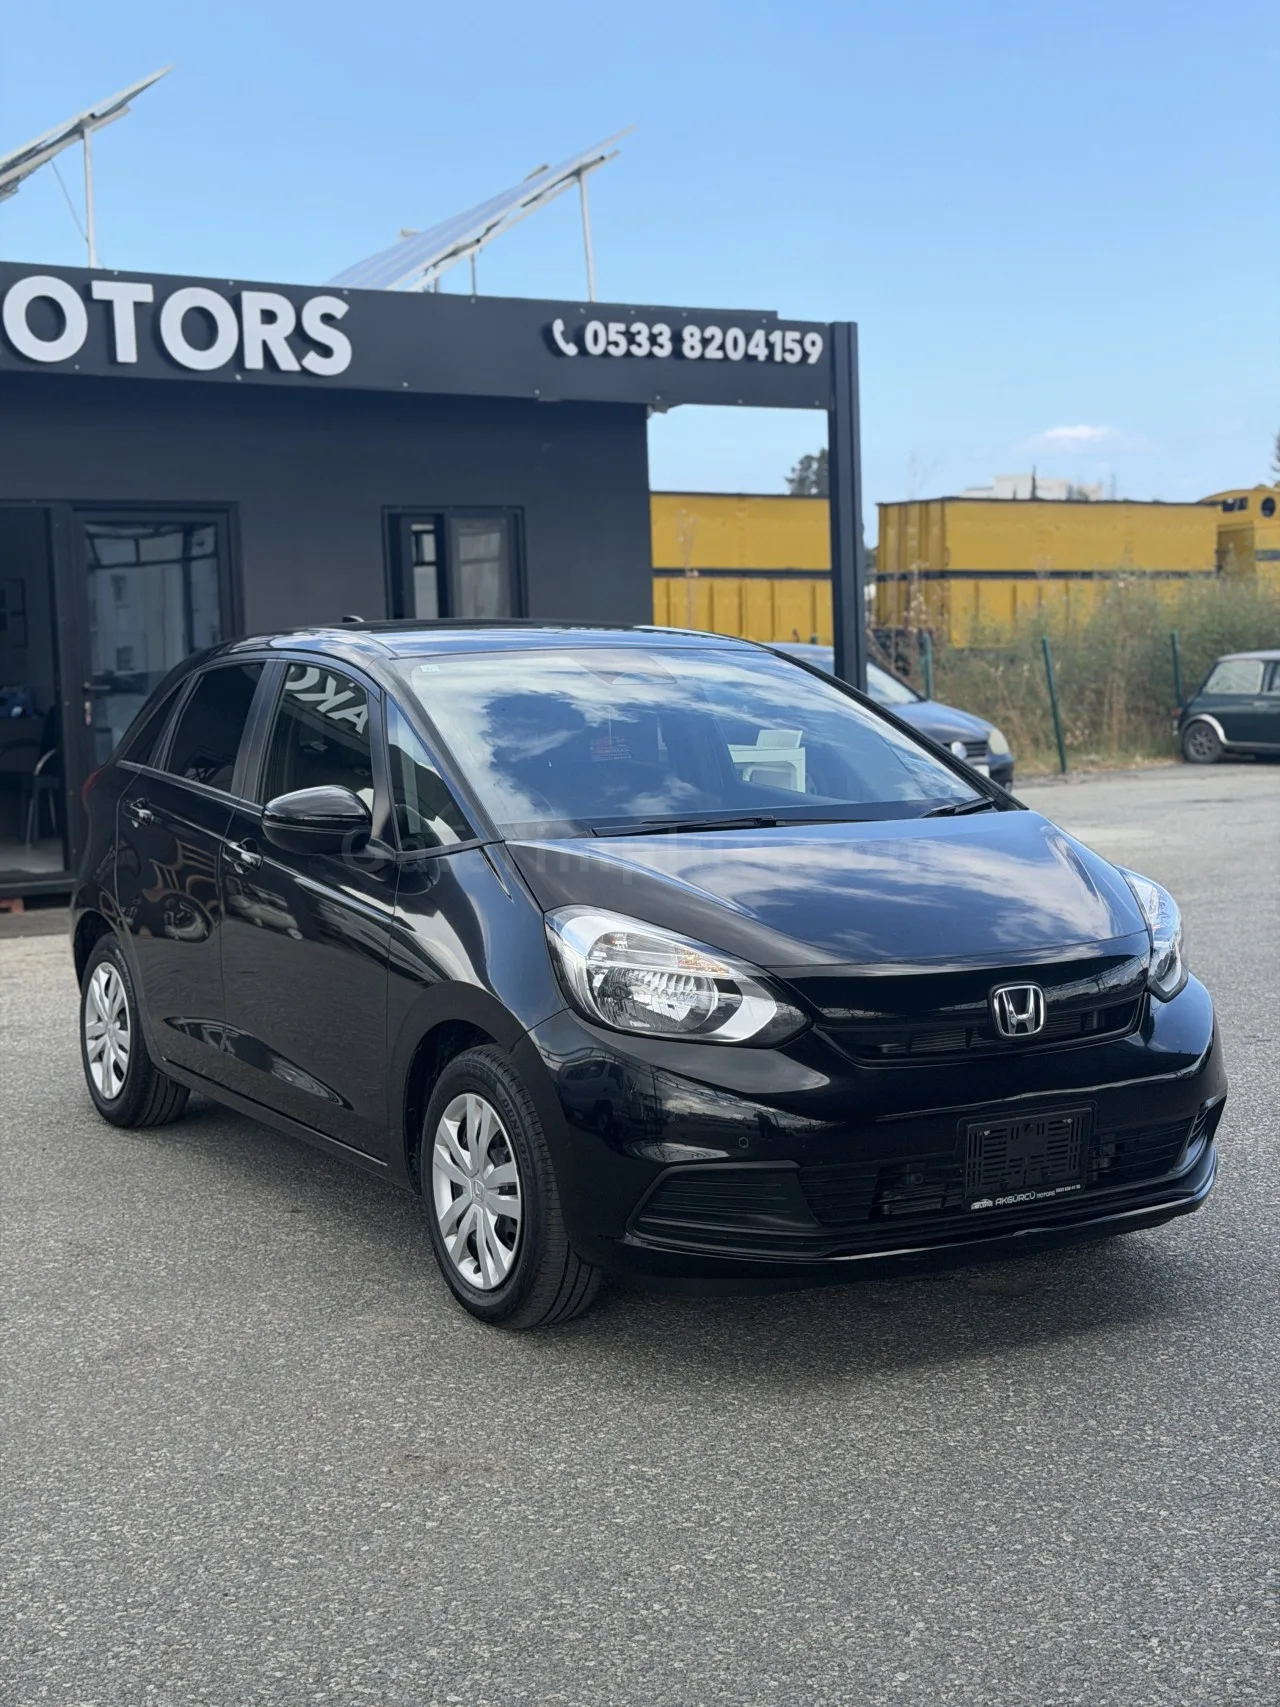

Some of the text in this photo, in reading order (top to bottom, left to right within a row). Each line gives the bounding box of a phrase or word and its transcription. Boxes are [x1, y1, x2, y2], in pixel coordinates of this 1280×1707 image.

[3, 275, 352, 376] OTORS
[584, 320, 823, 364] 0533 8204159
